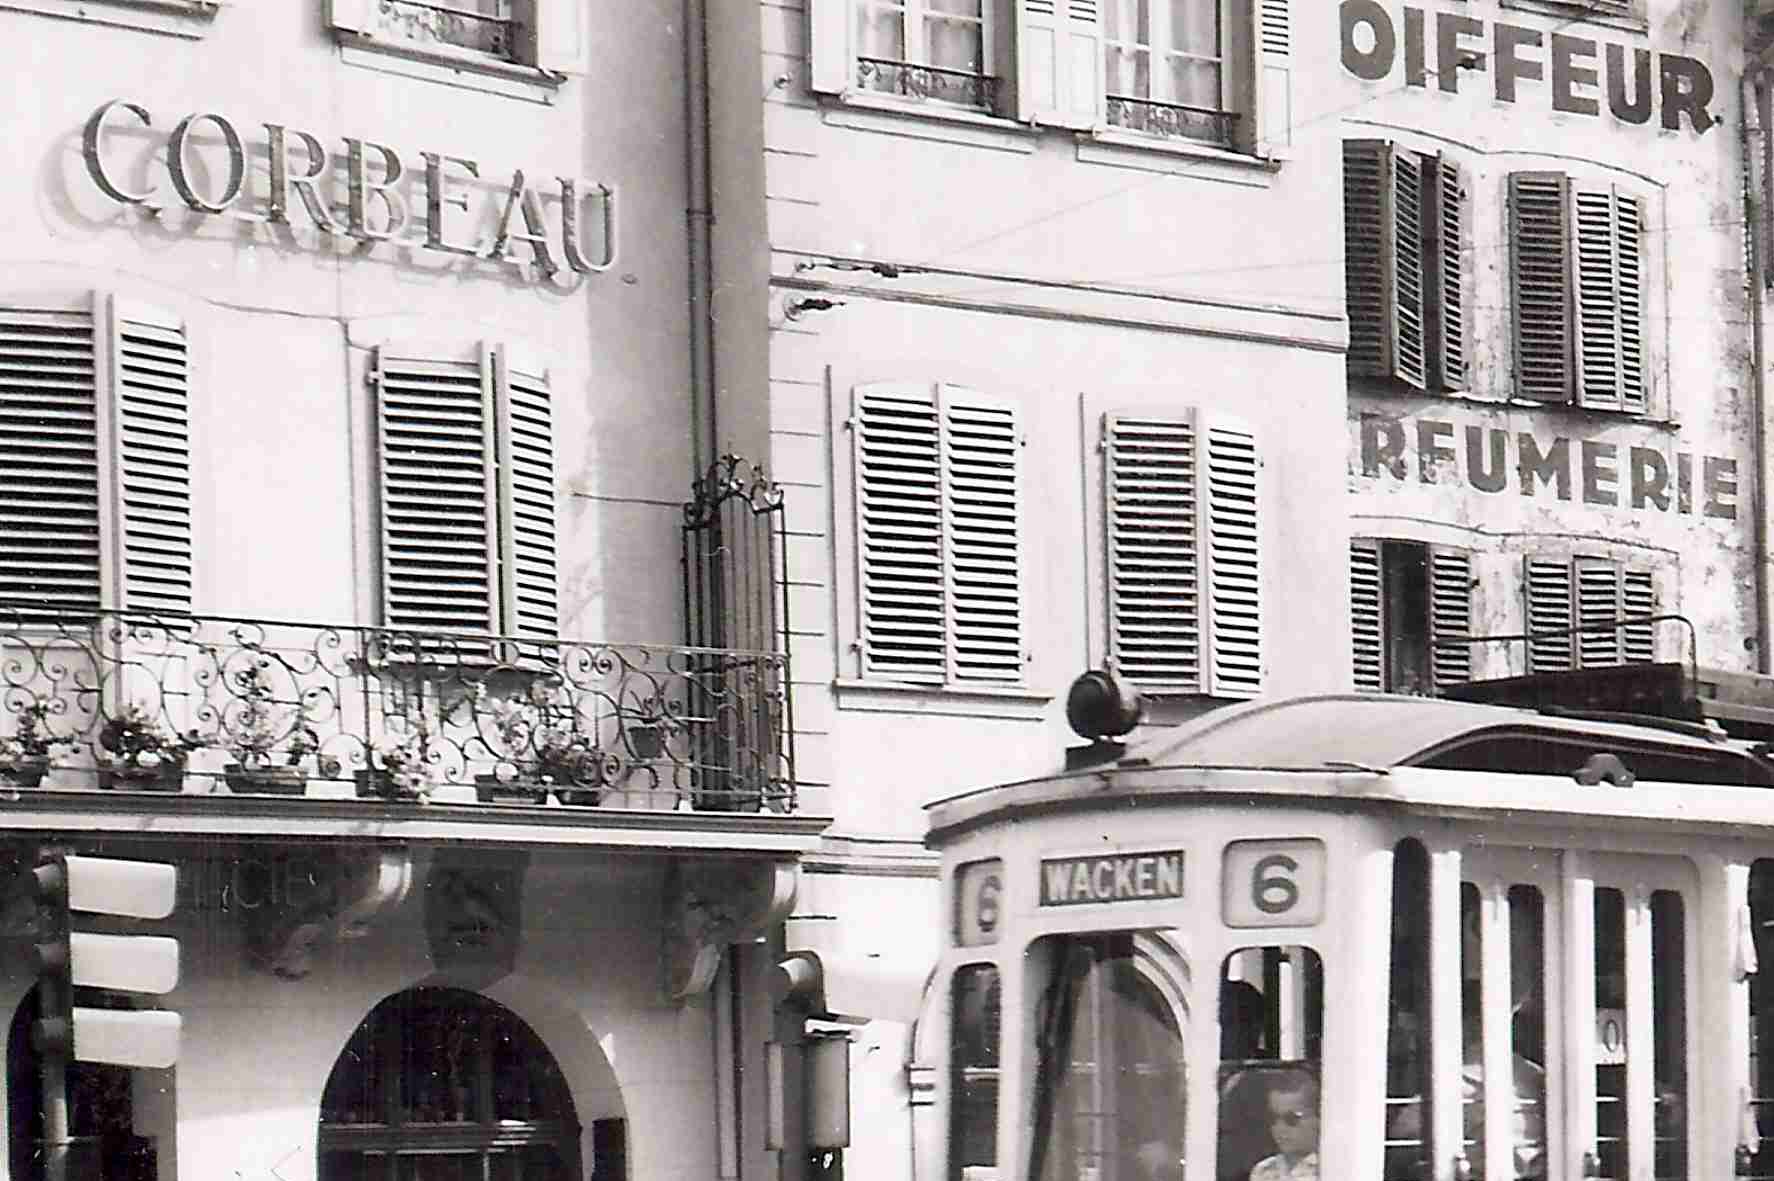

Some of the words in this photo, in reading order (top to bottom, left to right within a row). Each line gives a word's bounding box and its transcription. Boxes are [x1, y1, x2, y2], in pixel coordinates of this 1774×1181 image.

[1339, 0, 1716, 136] OIFFEUR
[82, 99, 616, 279] CORBEAU
[976, 874, 1003, 933] 6
[1045, 855, 1182, 901] WACKEN
[1252, 853, 1300, 915] 6
